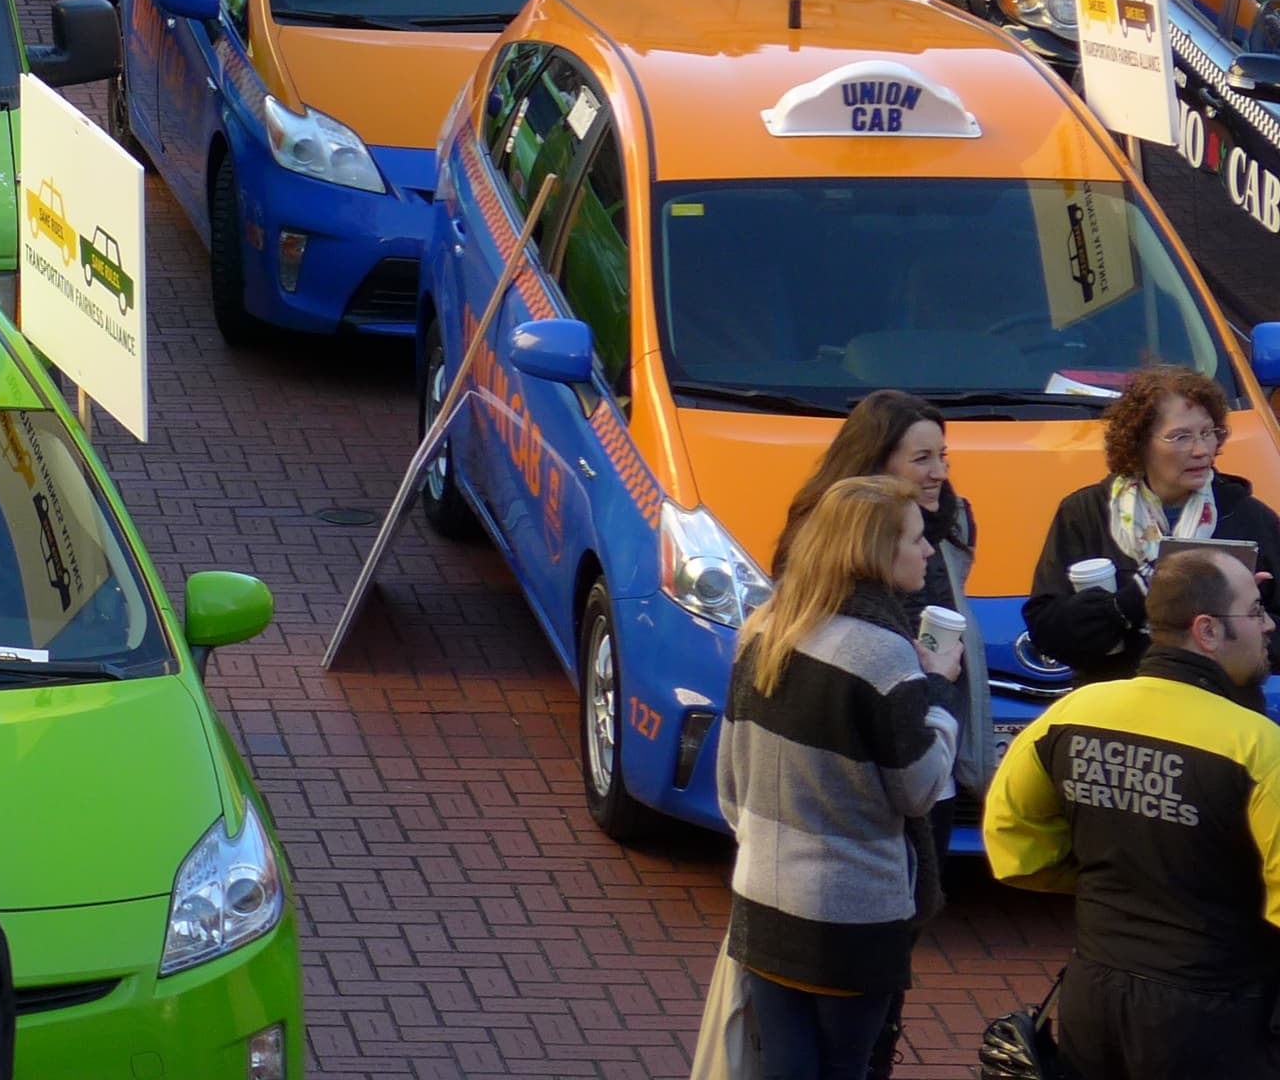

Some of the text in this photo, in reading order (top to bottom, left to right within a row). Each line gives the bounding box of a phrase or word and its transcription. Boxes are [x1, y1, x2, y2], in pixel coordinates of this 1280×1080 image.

[1083, 39, 1161, 72] TRANSPORTATION FAIRNESS ALLIANCE
[842, 81, 922, 111] UNION
[851, 107, 903, 132] CAB
[1228, 146, 1280, 234] CAB
[24, 243, 137, 357] TRANSPORTATION FAIRNESS ALLIANCE
[511, 393, 540, 497] CAB
[630, 697, 662, 740] 127
[1069, 735, 1184, 777] PACIFIC
[1072, 758, 1182, 802] PATROL
[1061, 779, 1200, 827] SERVICES
